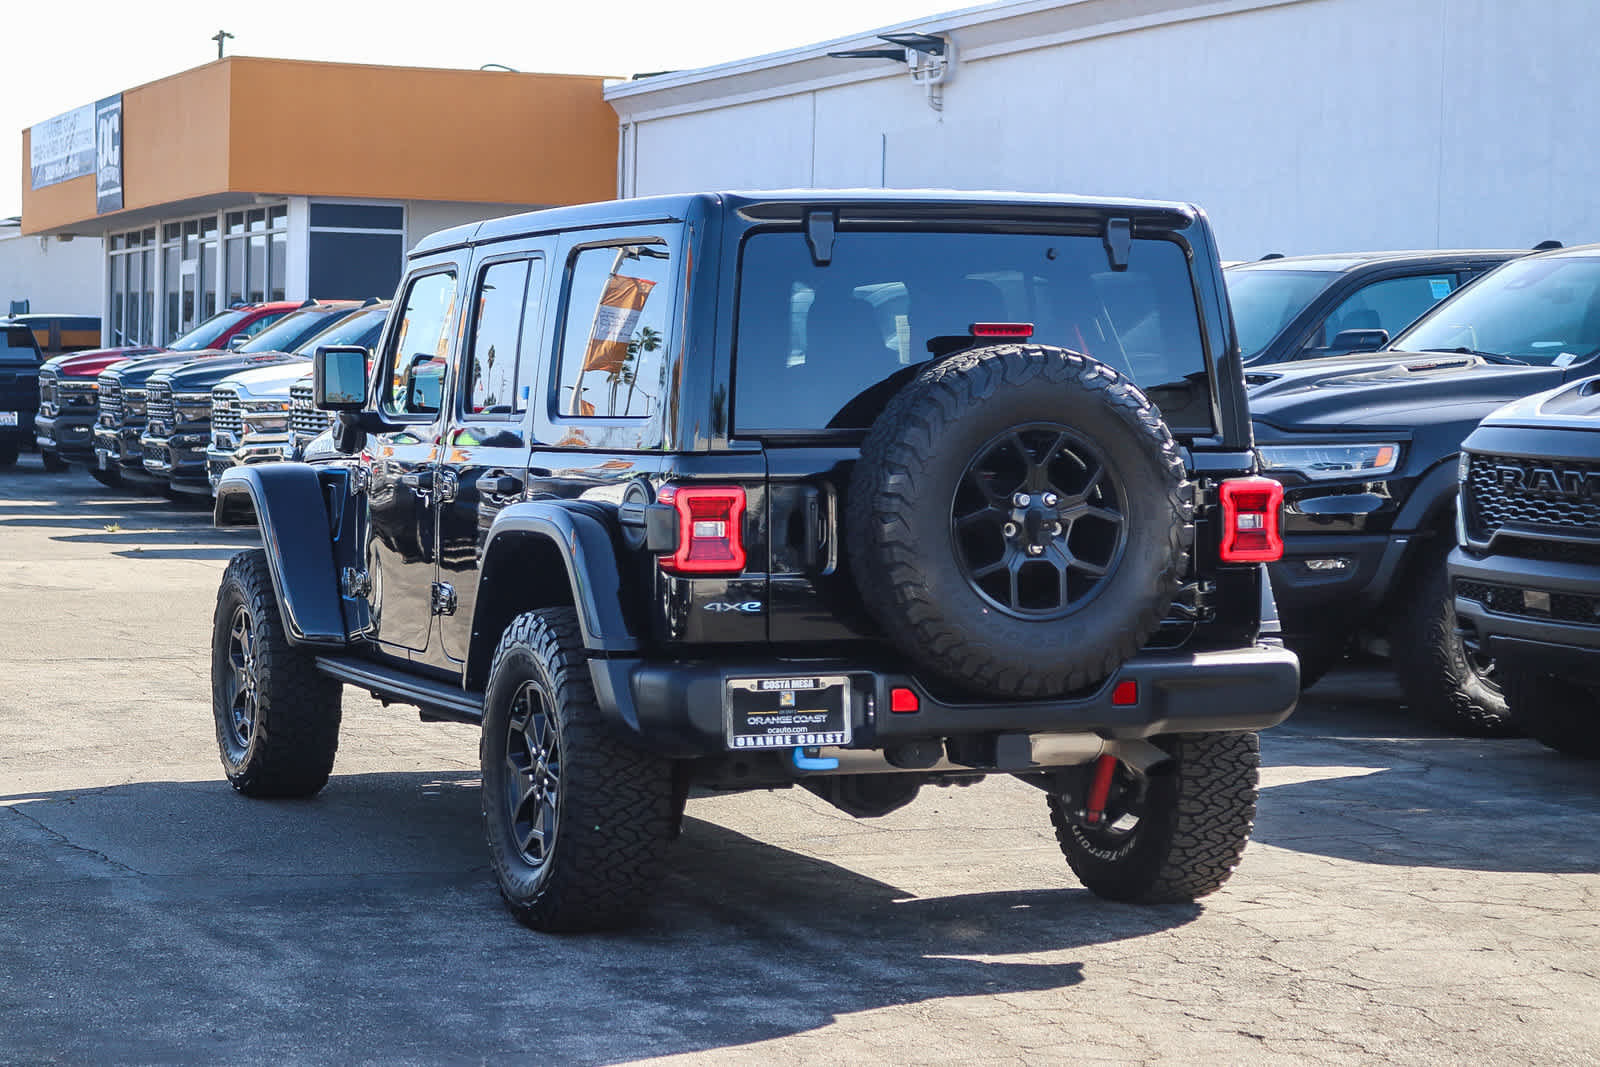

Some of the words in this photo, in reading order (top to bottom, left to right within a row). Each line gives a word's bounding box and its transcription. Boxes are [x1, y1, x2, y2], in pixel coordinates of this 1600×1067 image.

[1496, 466, 1600, 496] RAM
[763, 681, 790, 690] COSTA
[792, 679, 815, 689] MESA
[748, 715, 792, 725] ORANGE
[793, 714, 828, 724] COAST
[736, 735, 792, 747] ORANGE
[798, 734, 843, 744] COAST
